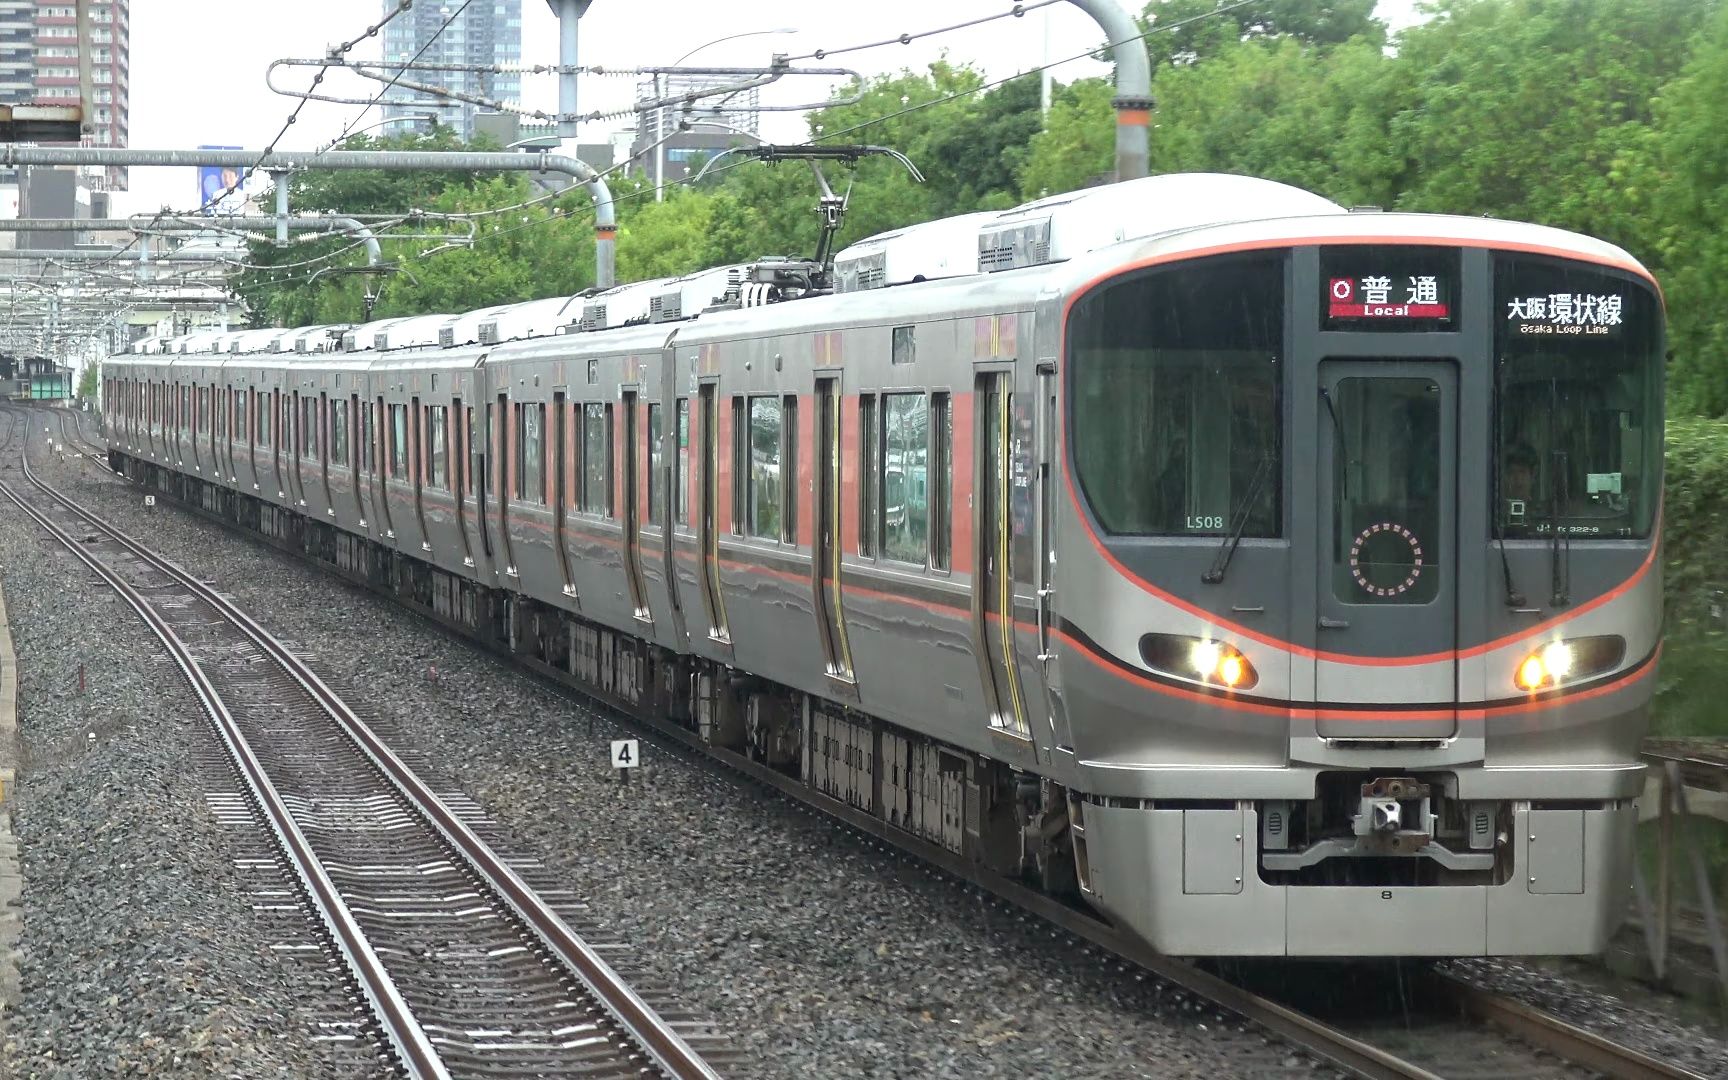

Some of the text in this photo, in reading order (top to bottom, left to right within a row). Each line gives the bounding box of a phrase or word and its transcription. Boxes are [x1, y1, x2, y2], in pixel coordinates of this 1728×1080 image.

[1360, 275, 1438, 304] 普通
[1364, 304, 1409, 316] Local
[1556, 324, 1582, 335] Loop
[1586, 324, 1608, 334] Line
[1187, 516, 1223, 529] LS08
[618, 743, 632, 764] 4
[1381, 890, 1393, 900] 8
